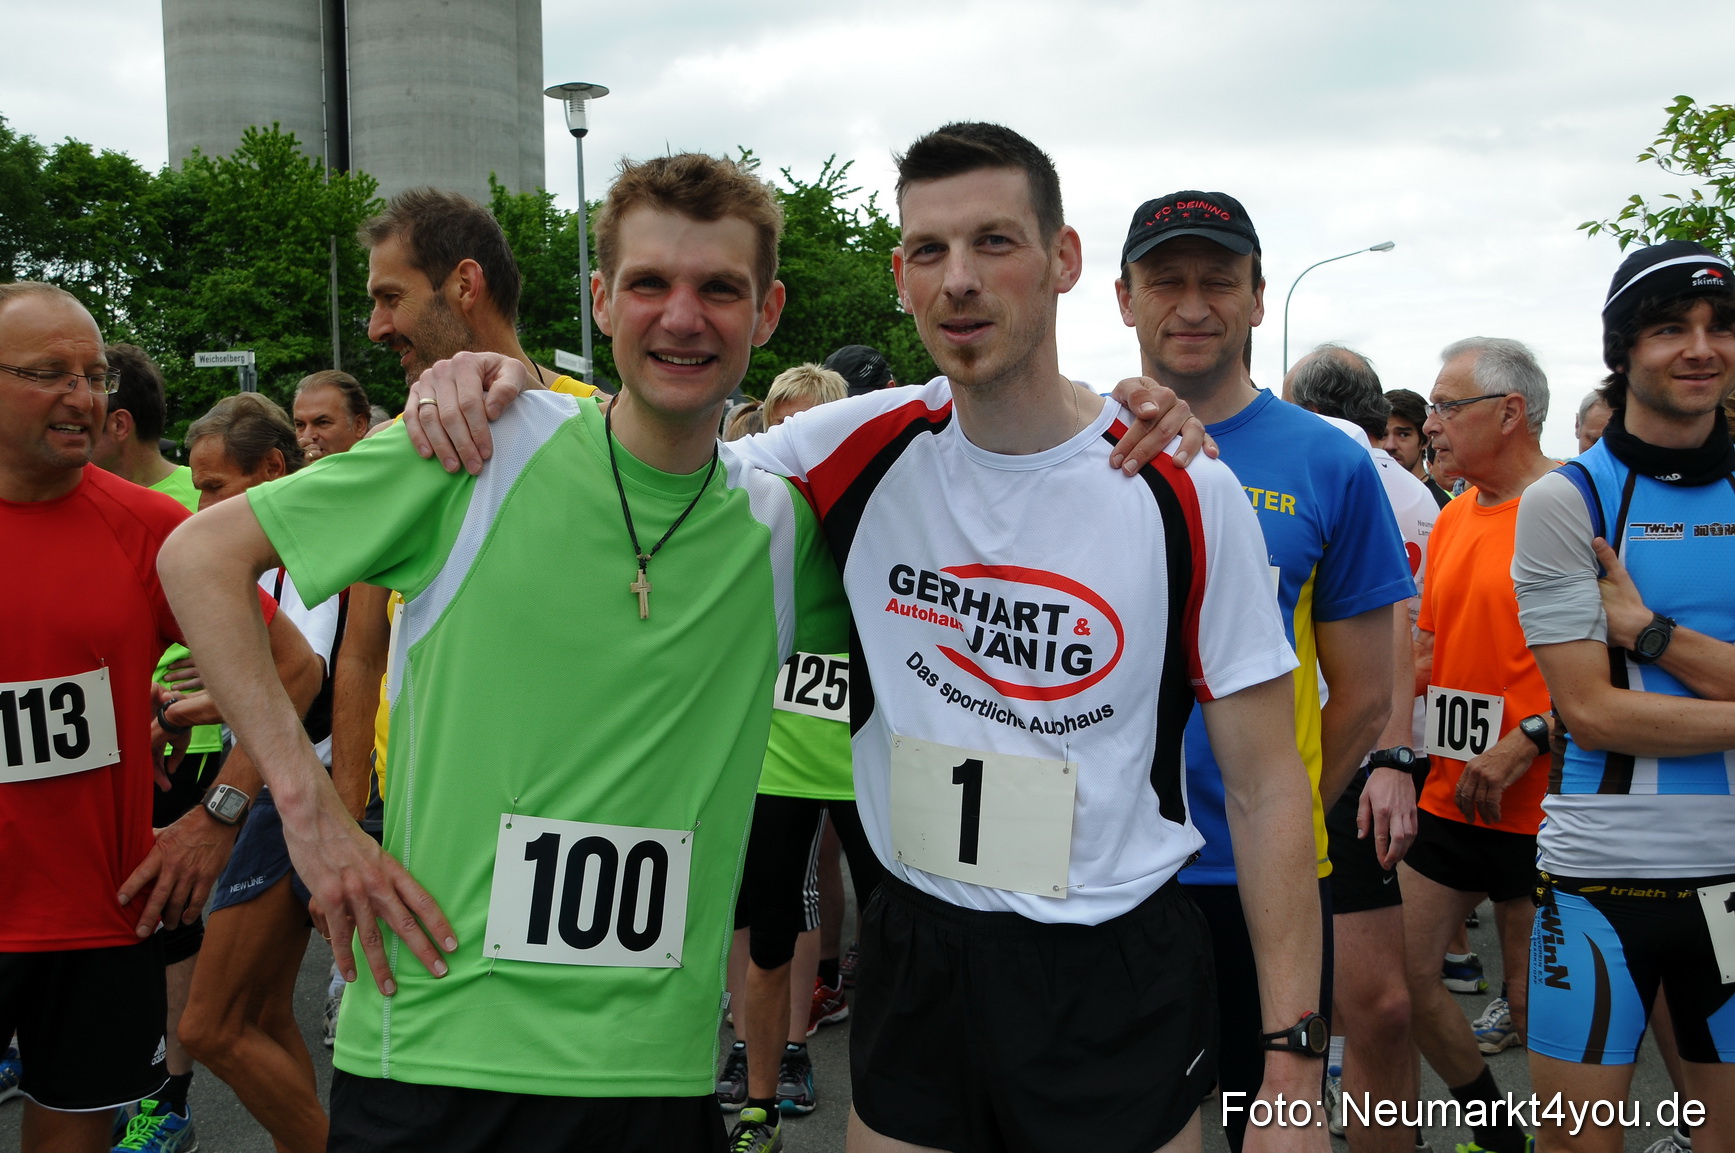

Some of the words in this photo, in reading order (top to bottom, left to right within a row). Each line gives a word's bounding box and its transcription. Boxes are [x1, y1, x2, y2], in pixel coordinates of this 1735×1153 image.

[1155, 206, 1171, 220] FC
[1177, 201, 1230, 221] DEINING
[1692, 277, 1724, 286] skinfit
[199, 354, 245, 364] Weichselberg
[889, 564, 1070, 636] GERHART
[1073, 618, 1091, 636] &
[965, 625, 1093, 676] JÄNIG
[784, 653, 849, 711] 125
[906, 651, 940, 687] Das
[939, 682, 1027, 729] sportliche
[1030, 704, 1114, 735] Auohaus
[0, 681, 90, 767] 113
[1436, 694, 1489, 755] 105
[952, 758, 984, 866] 1
[524, 832, 669, 952] 100
[1610, 886, 1692, 898] triathn
